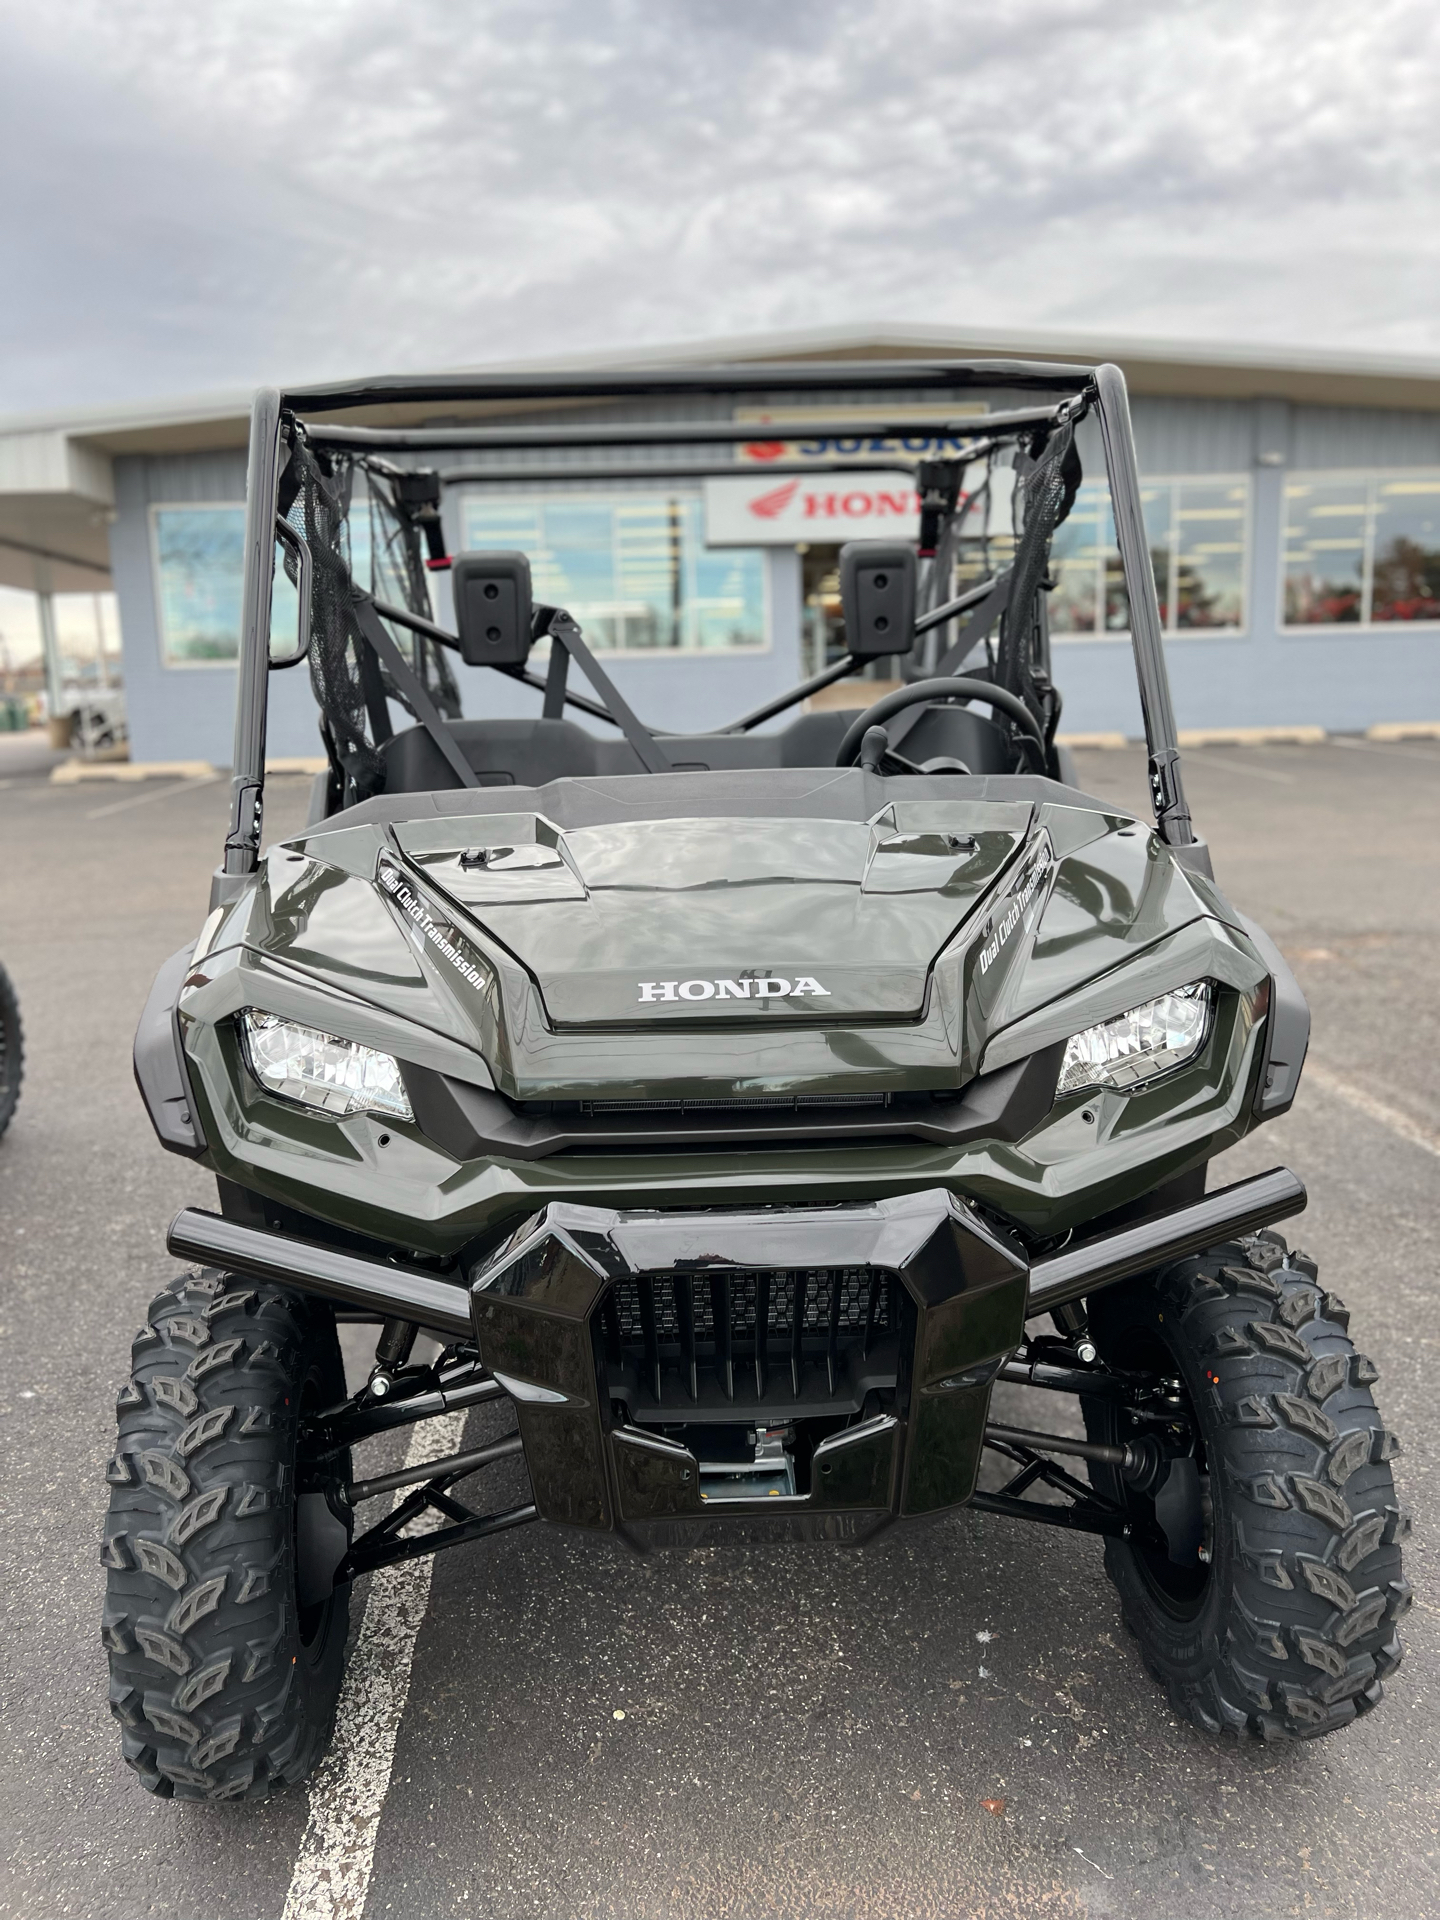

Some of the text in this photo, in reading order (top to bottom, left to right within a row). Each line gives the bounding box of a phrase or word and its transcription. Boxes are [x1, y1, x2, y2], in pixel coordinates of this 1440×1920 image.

[801, 437, 983, 456] SUZUK
[381, 868, 486, 990] Dual Clutch Transmission
[979, 847, 1049, 975] Dual Clutch Transmission
[638, 977, 831, 1002] HONDA
